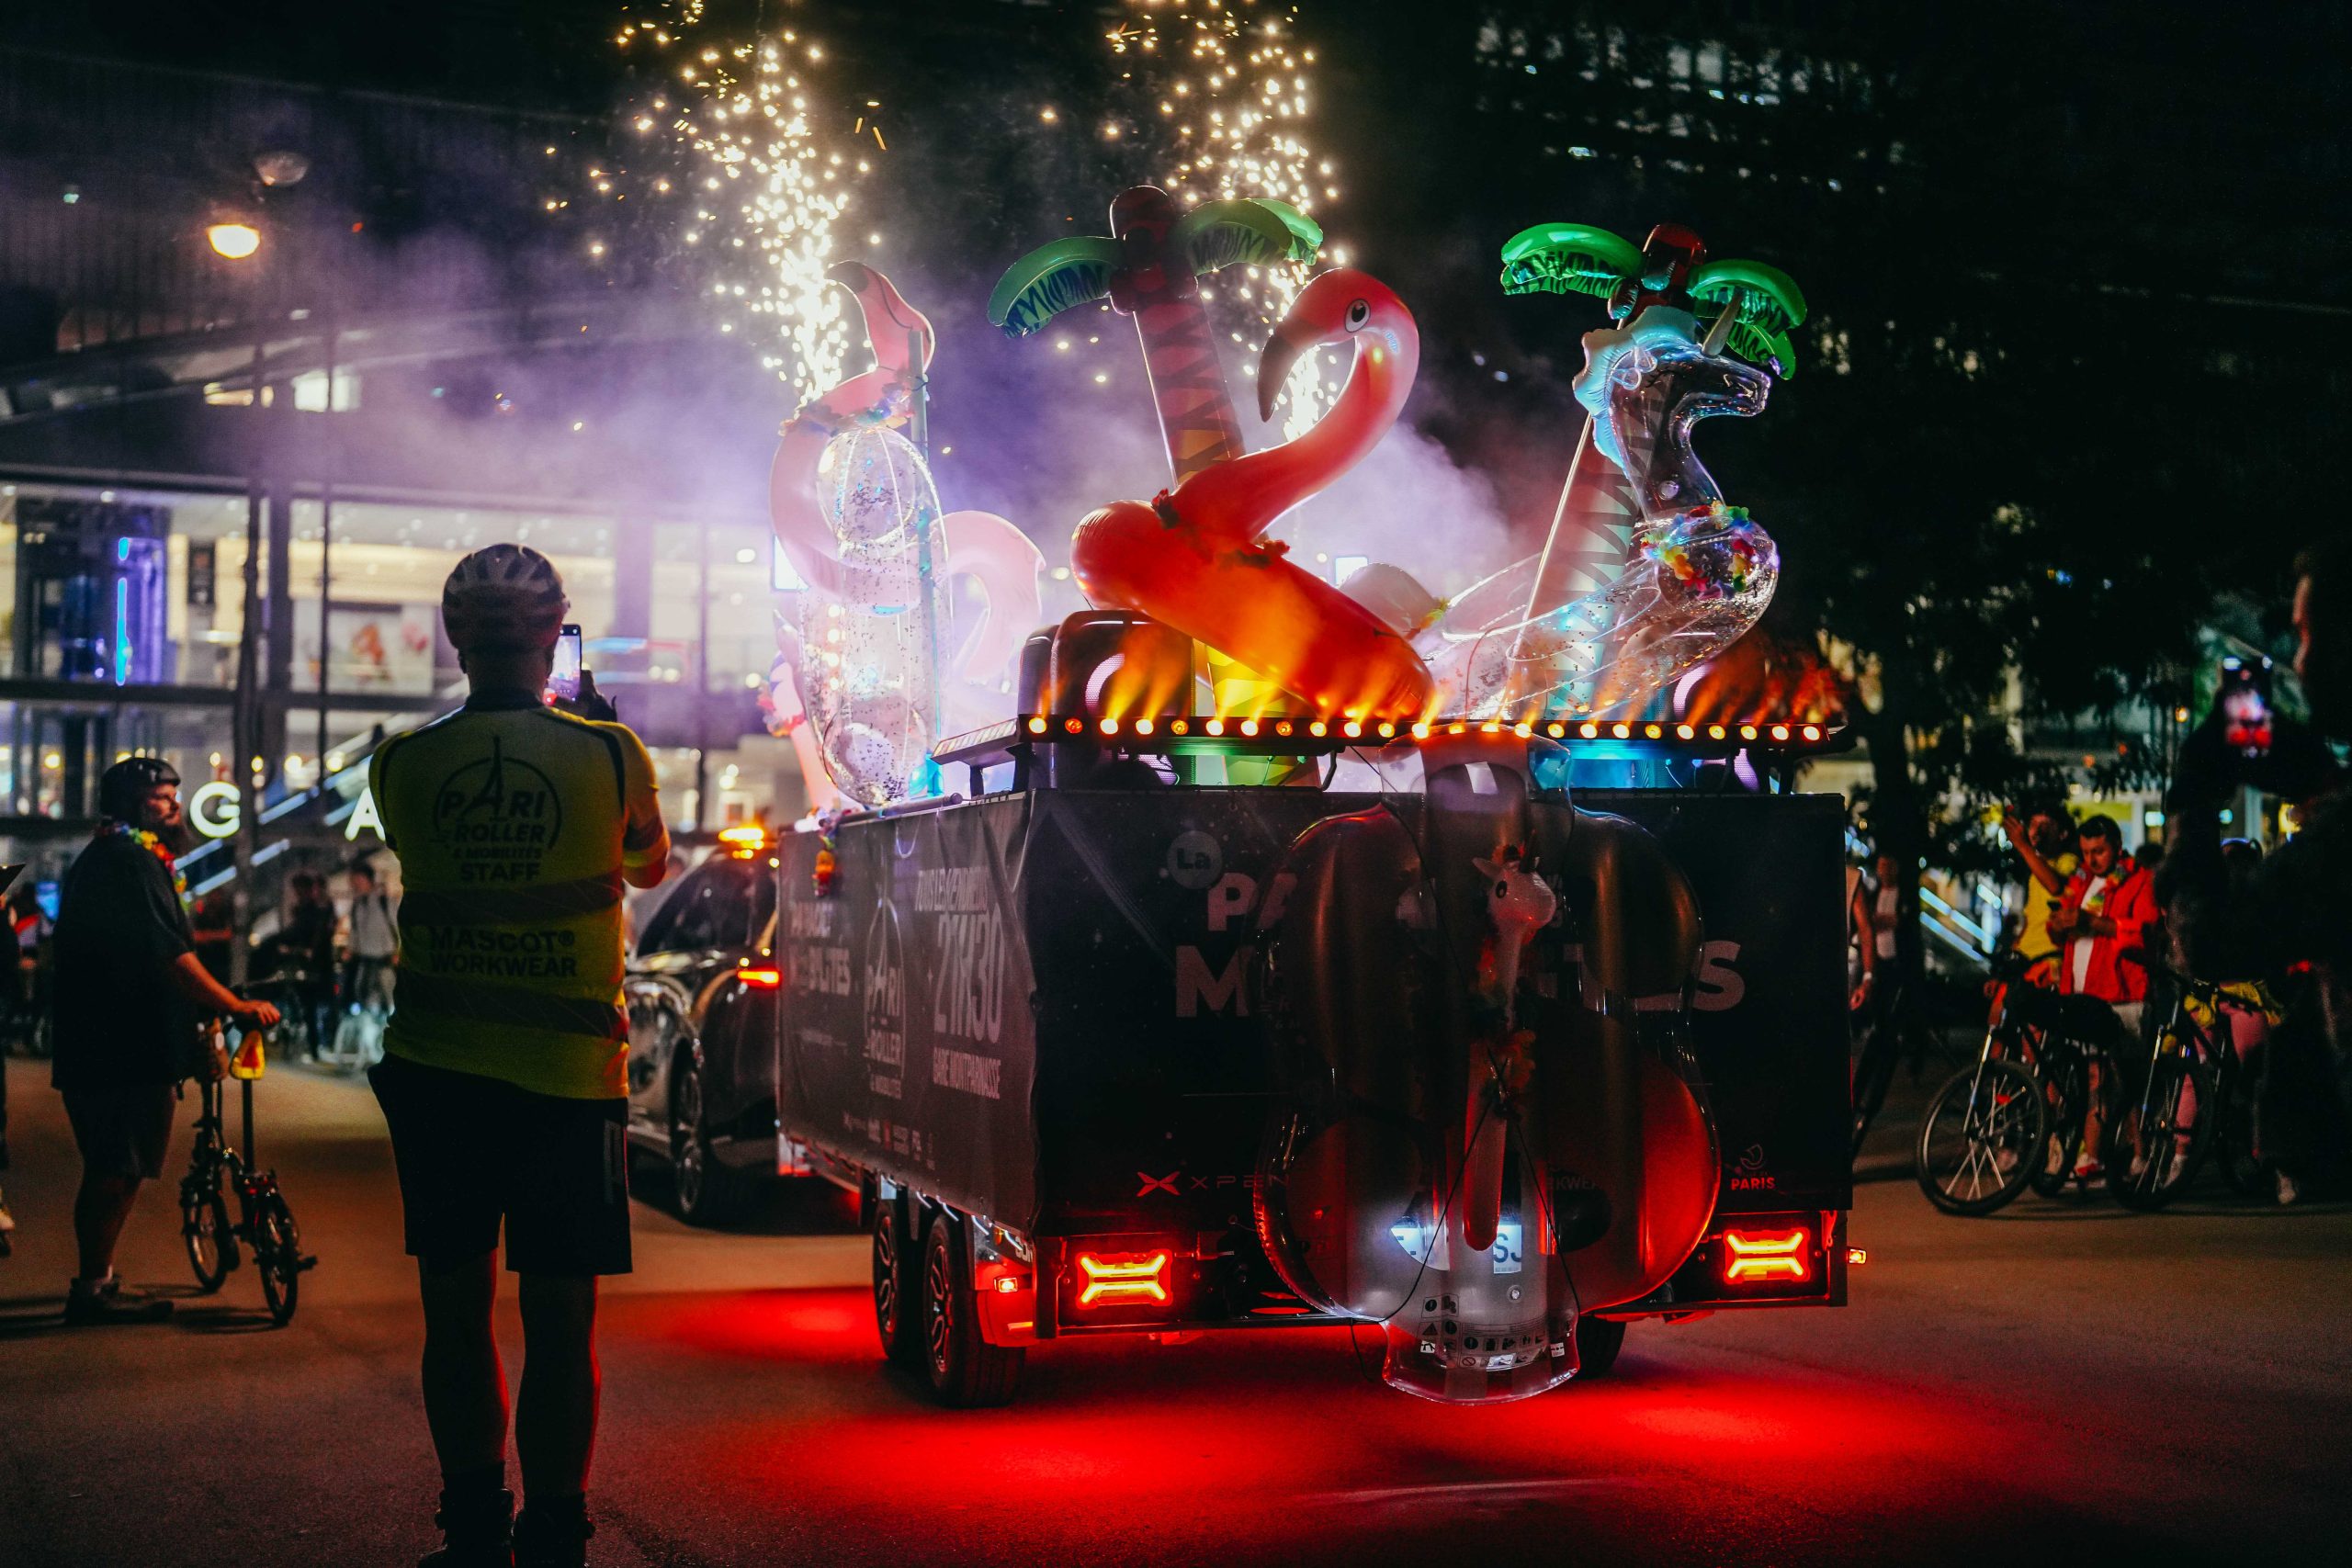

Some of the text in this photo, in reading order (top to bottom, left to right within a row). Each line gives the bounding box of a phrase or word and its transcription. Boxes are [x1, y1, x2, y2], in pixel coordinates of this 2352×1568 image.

[189, 782, 387, 841] G A
[455, 825, 547, 842] ROLLER
[1175, 848, 1211, 870] La
[460, 862, 540, 883] STAFF
[430, 953, 577, 977] WORKWEAR
[933, 902, 1006, 1044] 21H30
[1190, 1174, 1291, 1190] XPEN
[1730, 1177, 1777, 1191] PARIS
